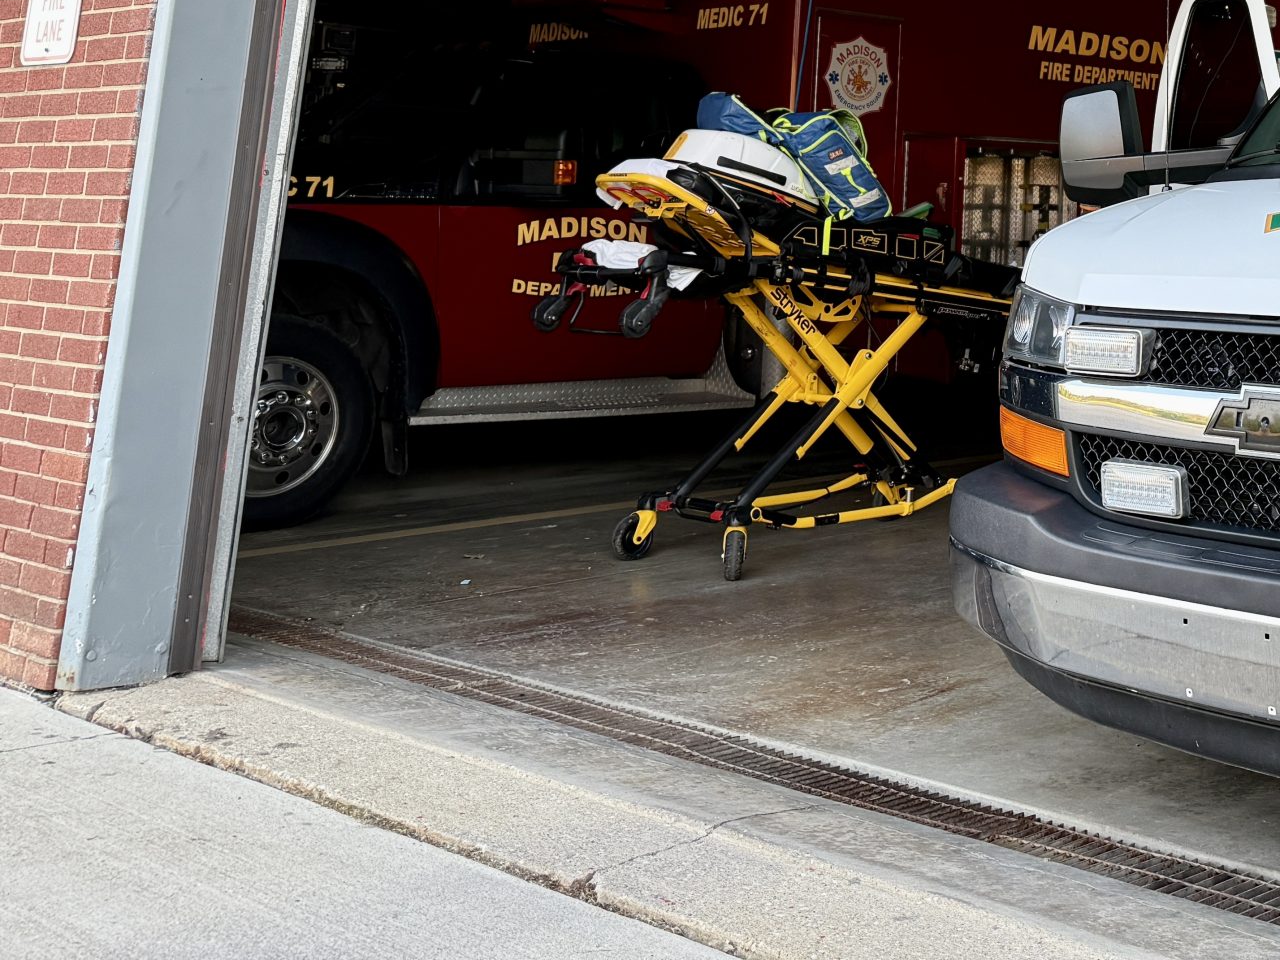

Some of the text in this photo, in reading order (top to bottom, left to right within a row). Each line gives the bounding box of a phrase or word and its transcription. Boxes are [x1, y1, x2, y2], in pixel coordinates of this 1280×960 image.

[697, 2, 769, 30] MEDIC 71
[35, 19, 65, 43] LANE
[836, 44, 883, 69] MADISON
[1028, 25, 1168, 65] MADISON
[1039, 61, 1072, 82] FIRE
[834, 89, 882, 111] EMERGENCY SQUAD
[305, 175, 335, 198] 71
[517, 217, 648, 246] MADISON
[857, 234, 881, 246] XPS
[511, 278, 640, 298] DEPAMEN
[770, 287, 816, 335] stryker
